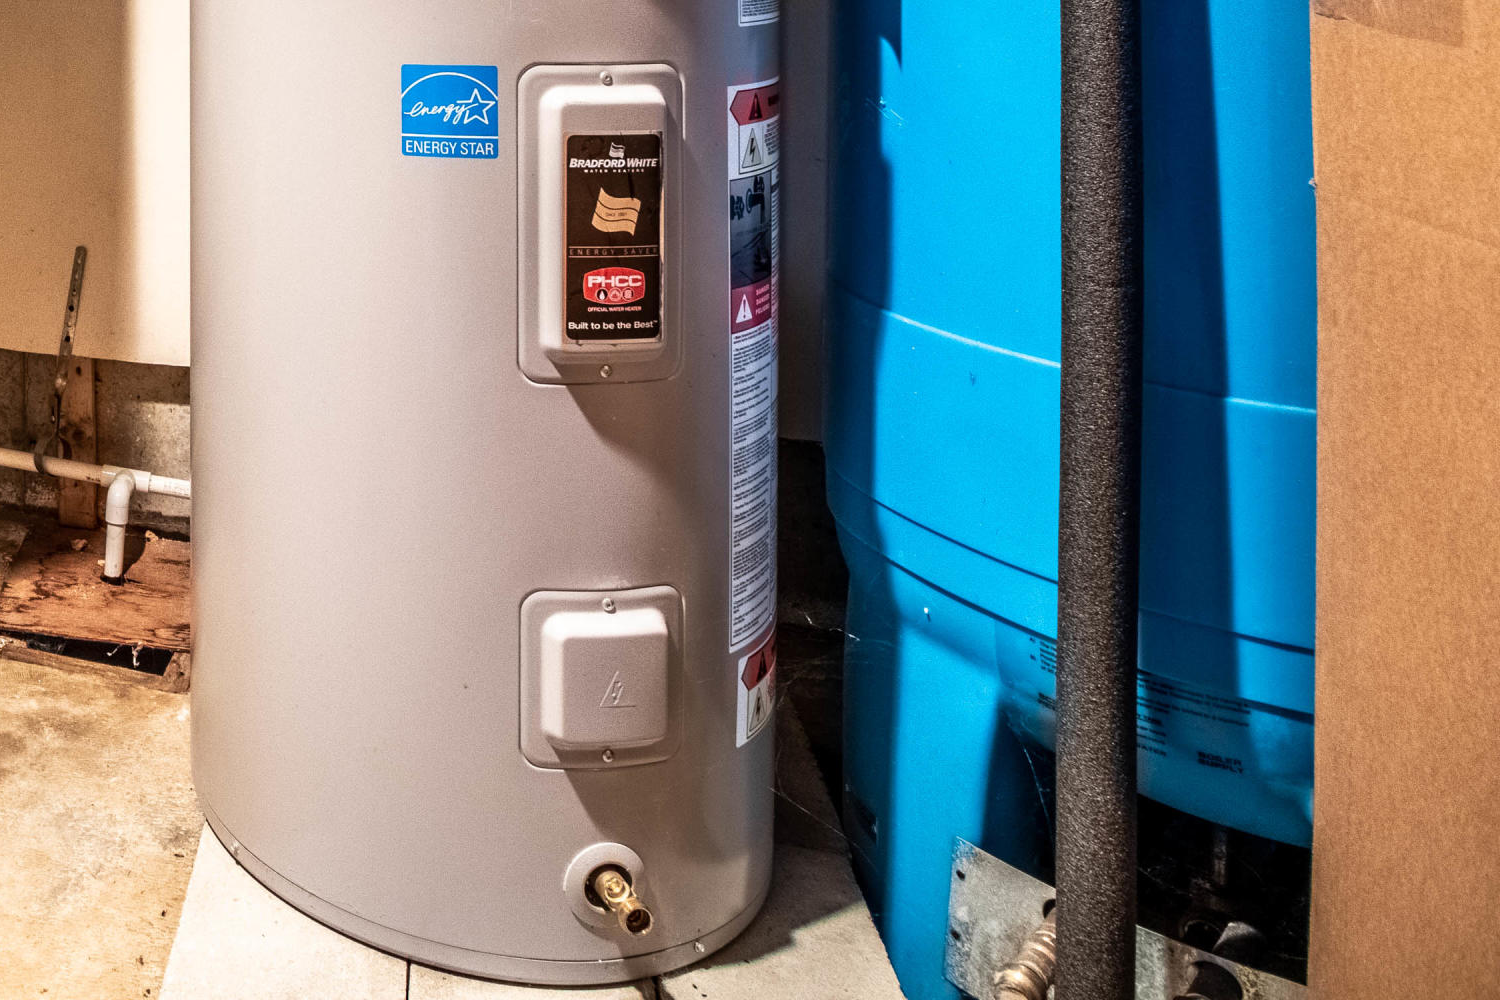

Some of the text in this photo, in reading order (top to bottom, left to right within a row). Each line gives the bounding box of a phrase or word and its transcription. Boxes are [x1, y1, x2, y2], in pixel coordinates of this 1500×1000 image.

[404, 101, 470, 125] energy
[405, 140, 494, 155] ENERGY STAR
[569, 158, 658, 168] BRADFORD WHITE
[569, 248, 615, 256] ENERGY
[587, 275, 642, 288] PHCC
[568, 321, 589, 330] Built
